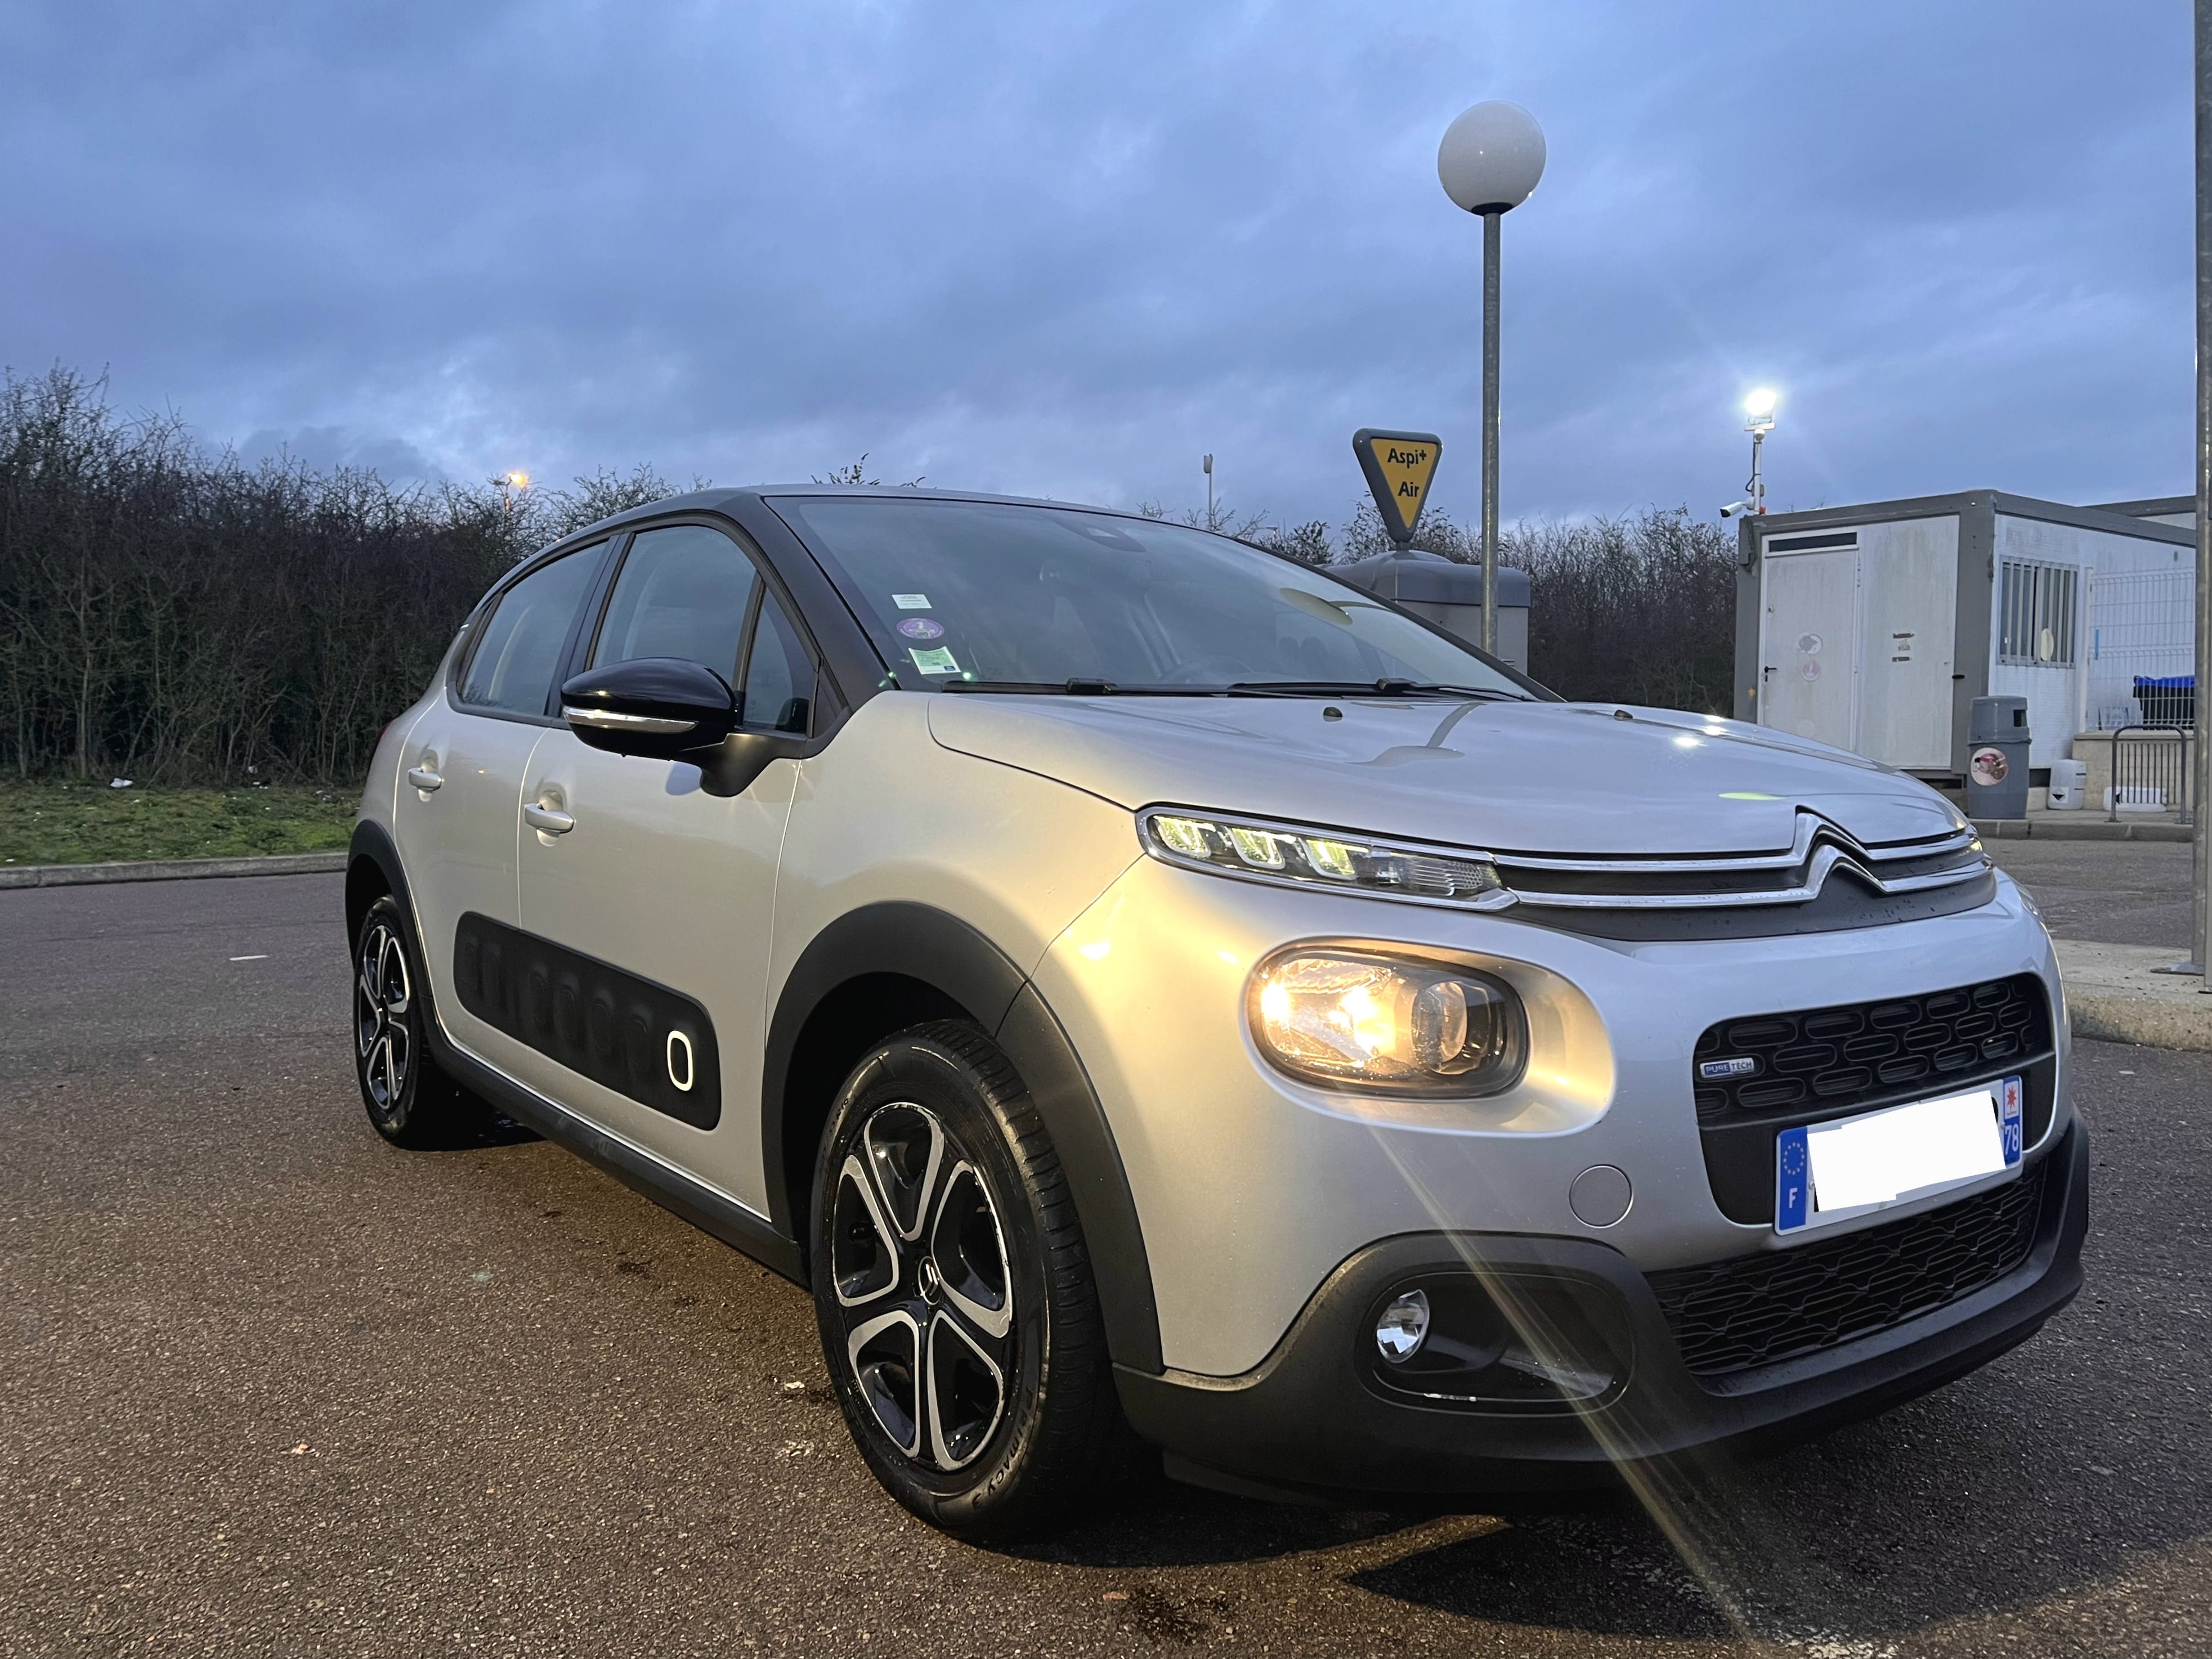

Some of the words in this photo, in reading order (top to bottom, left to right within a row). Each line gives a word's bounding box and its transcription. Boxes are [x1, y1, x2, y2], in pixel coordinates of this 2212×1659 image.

[1387, 448, 1427, 469] Aspi+
[1398, 481, 1420, 497] Air
[1705, 1064, 1730, 1074] PURE
[1731, 1061, 1752, 1070] TECH
[2005, 1123, 2019, 1155] 78
[1789, 1187, 1798, 1209] F
[989, 1386, 1033, 1496] PRIMACY
